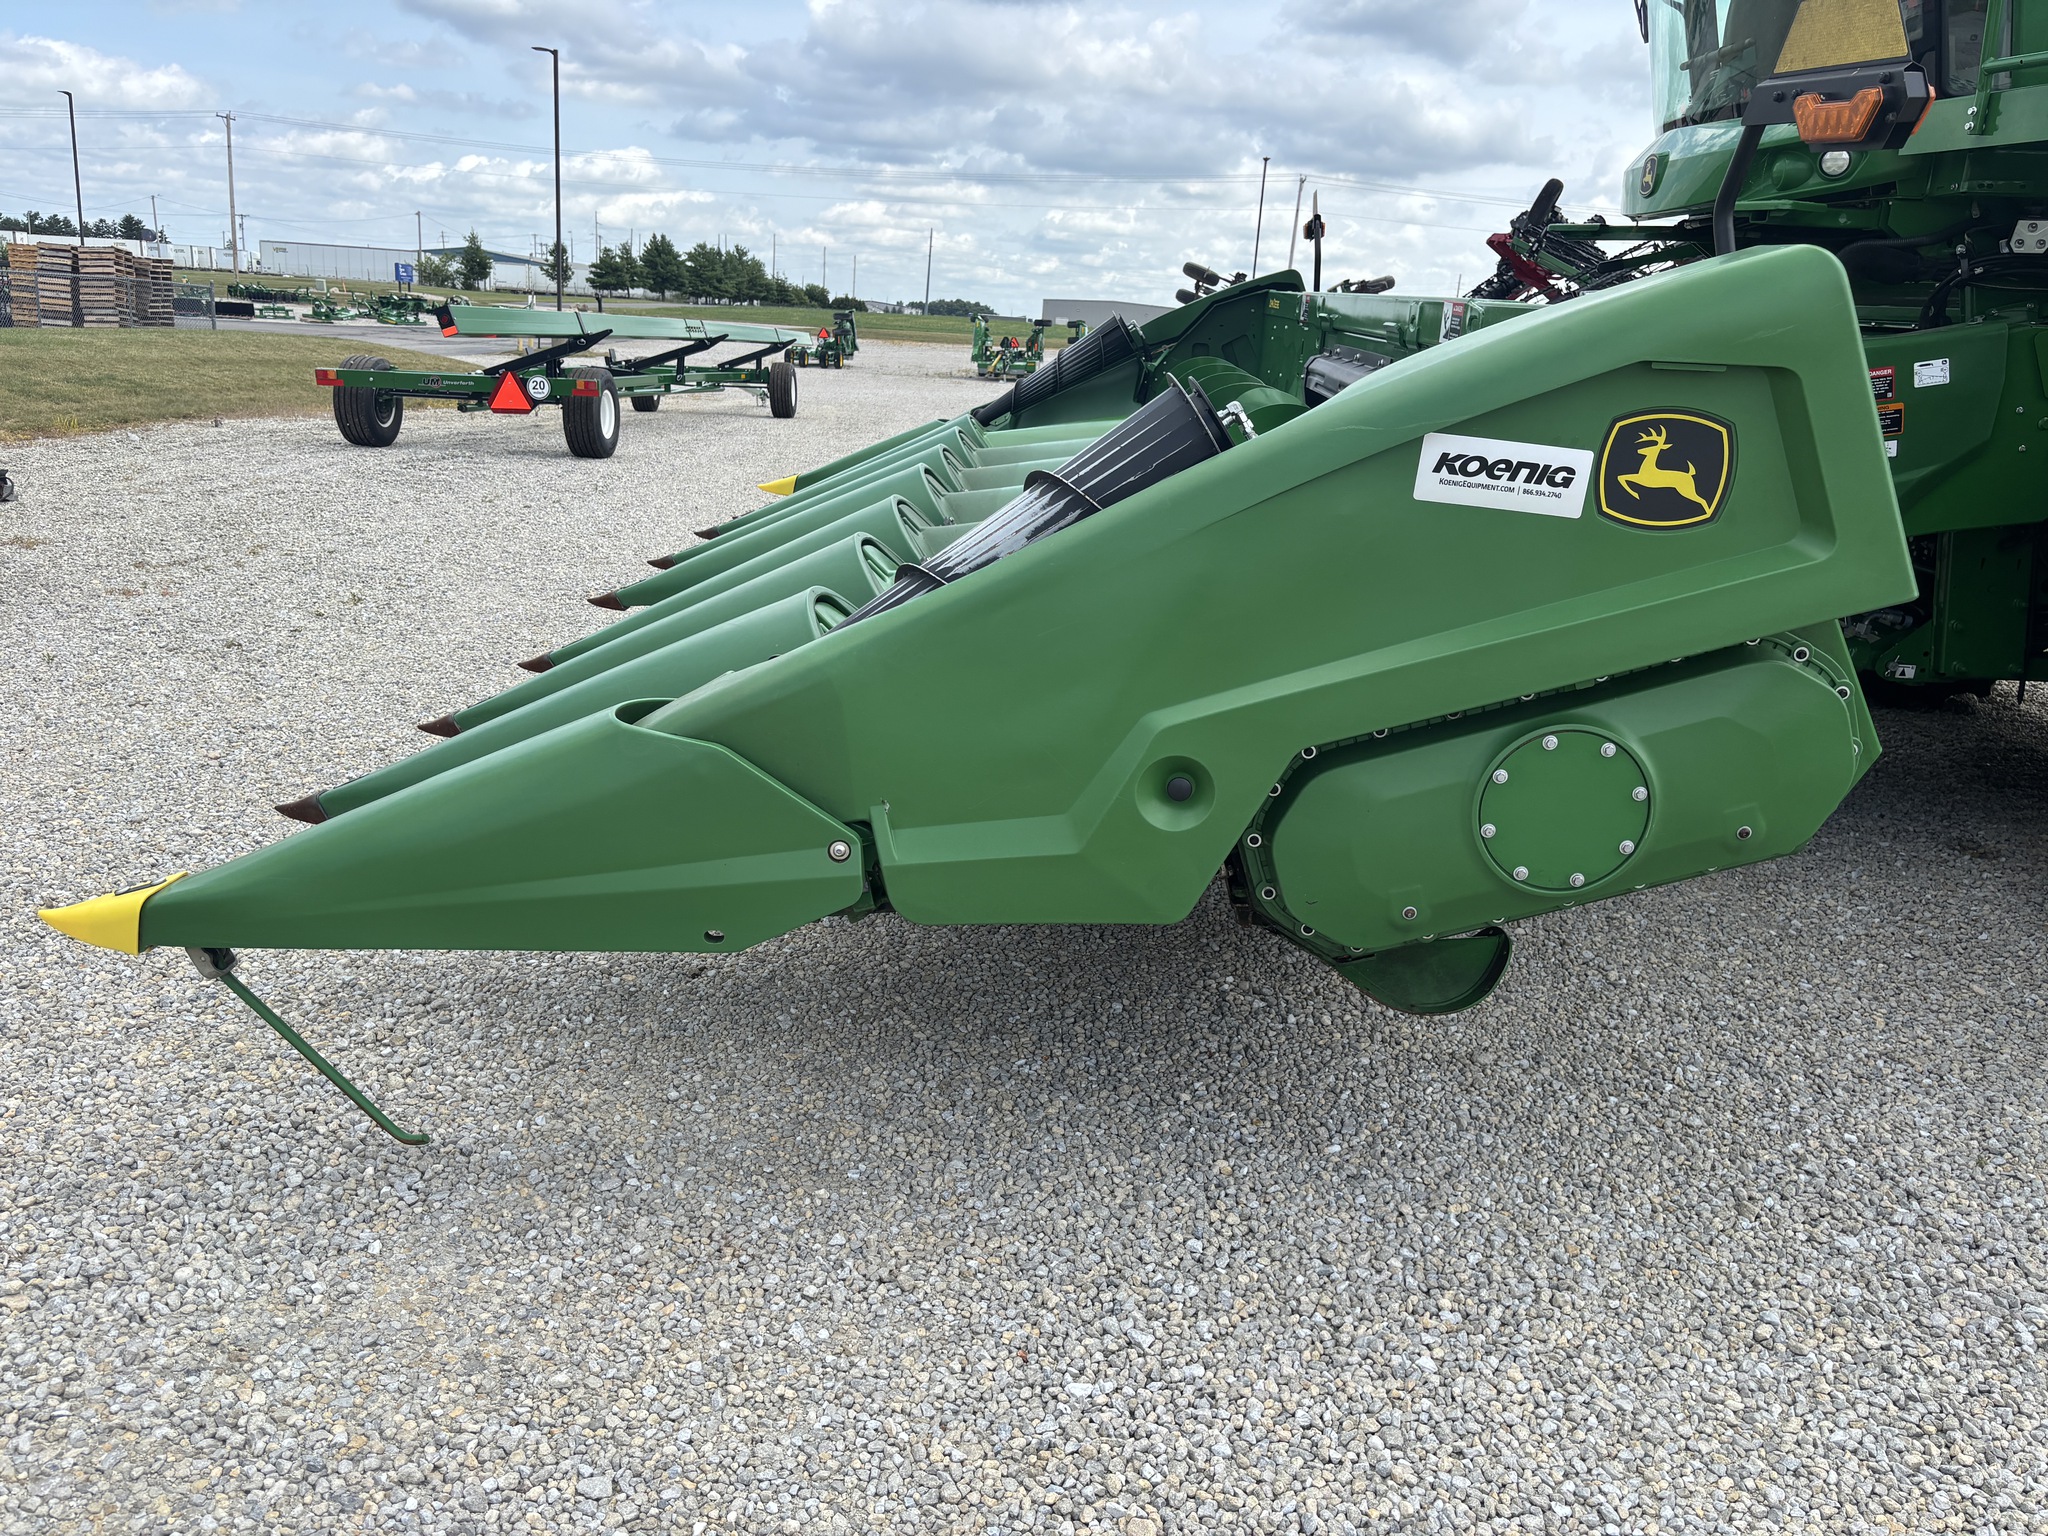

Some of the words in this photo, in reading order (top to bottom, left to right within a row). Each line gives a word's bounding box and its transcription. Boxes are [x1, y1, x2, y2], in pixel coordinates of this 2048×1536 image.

[422, 377, 441, 386] UM
[532, 380, 545, 390] 20
[1522, 488, 1562, 499] 866.934.2740
